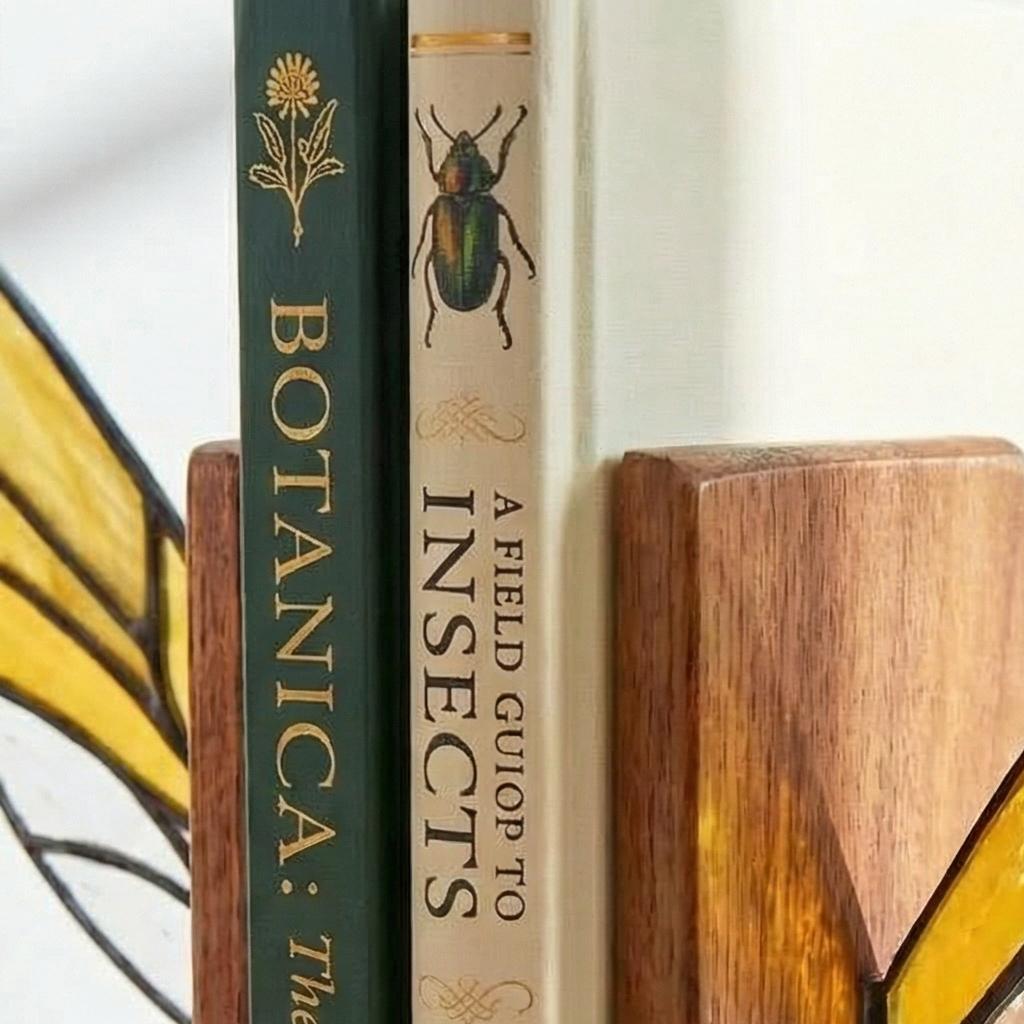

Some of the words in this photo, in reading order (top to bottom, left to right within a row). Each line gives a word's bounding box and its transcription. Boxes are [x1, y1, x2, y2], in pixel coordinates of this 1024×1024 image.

[494, 489, 524, 520] A
[270, 296, 336, 895] BOTANICA:
[494, 537, 524, 672] FIELD
[422, 486, 478, 919] INSECTS
[494, 692, 525, 841] GUIOP
[494, 858, 526, 921] TO
